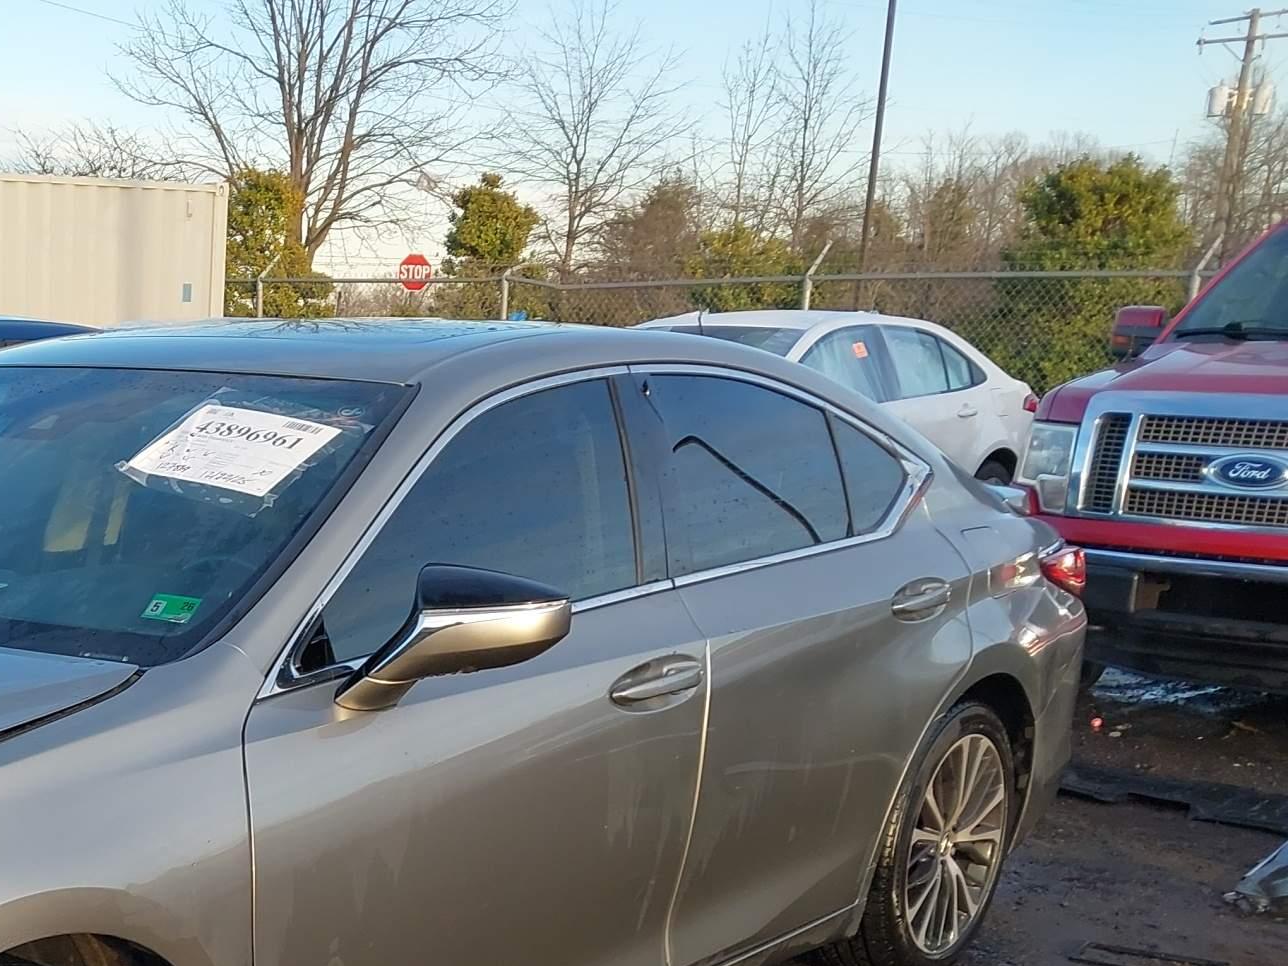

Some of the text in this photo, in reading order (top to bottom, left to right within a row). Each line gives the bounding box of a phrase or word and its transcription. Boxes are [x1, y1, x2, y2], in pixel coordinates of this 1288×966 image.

[400, 264, 430, 279] STOP
[196, 420, 304, 449] 43896961
[1228, 462, 1271, 479] Ford
[151, 602, 162, 613] 5
